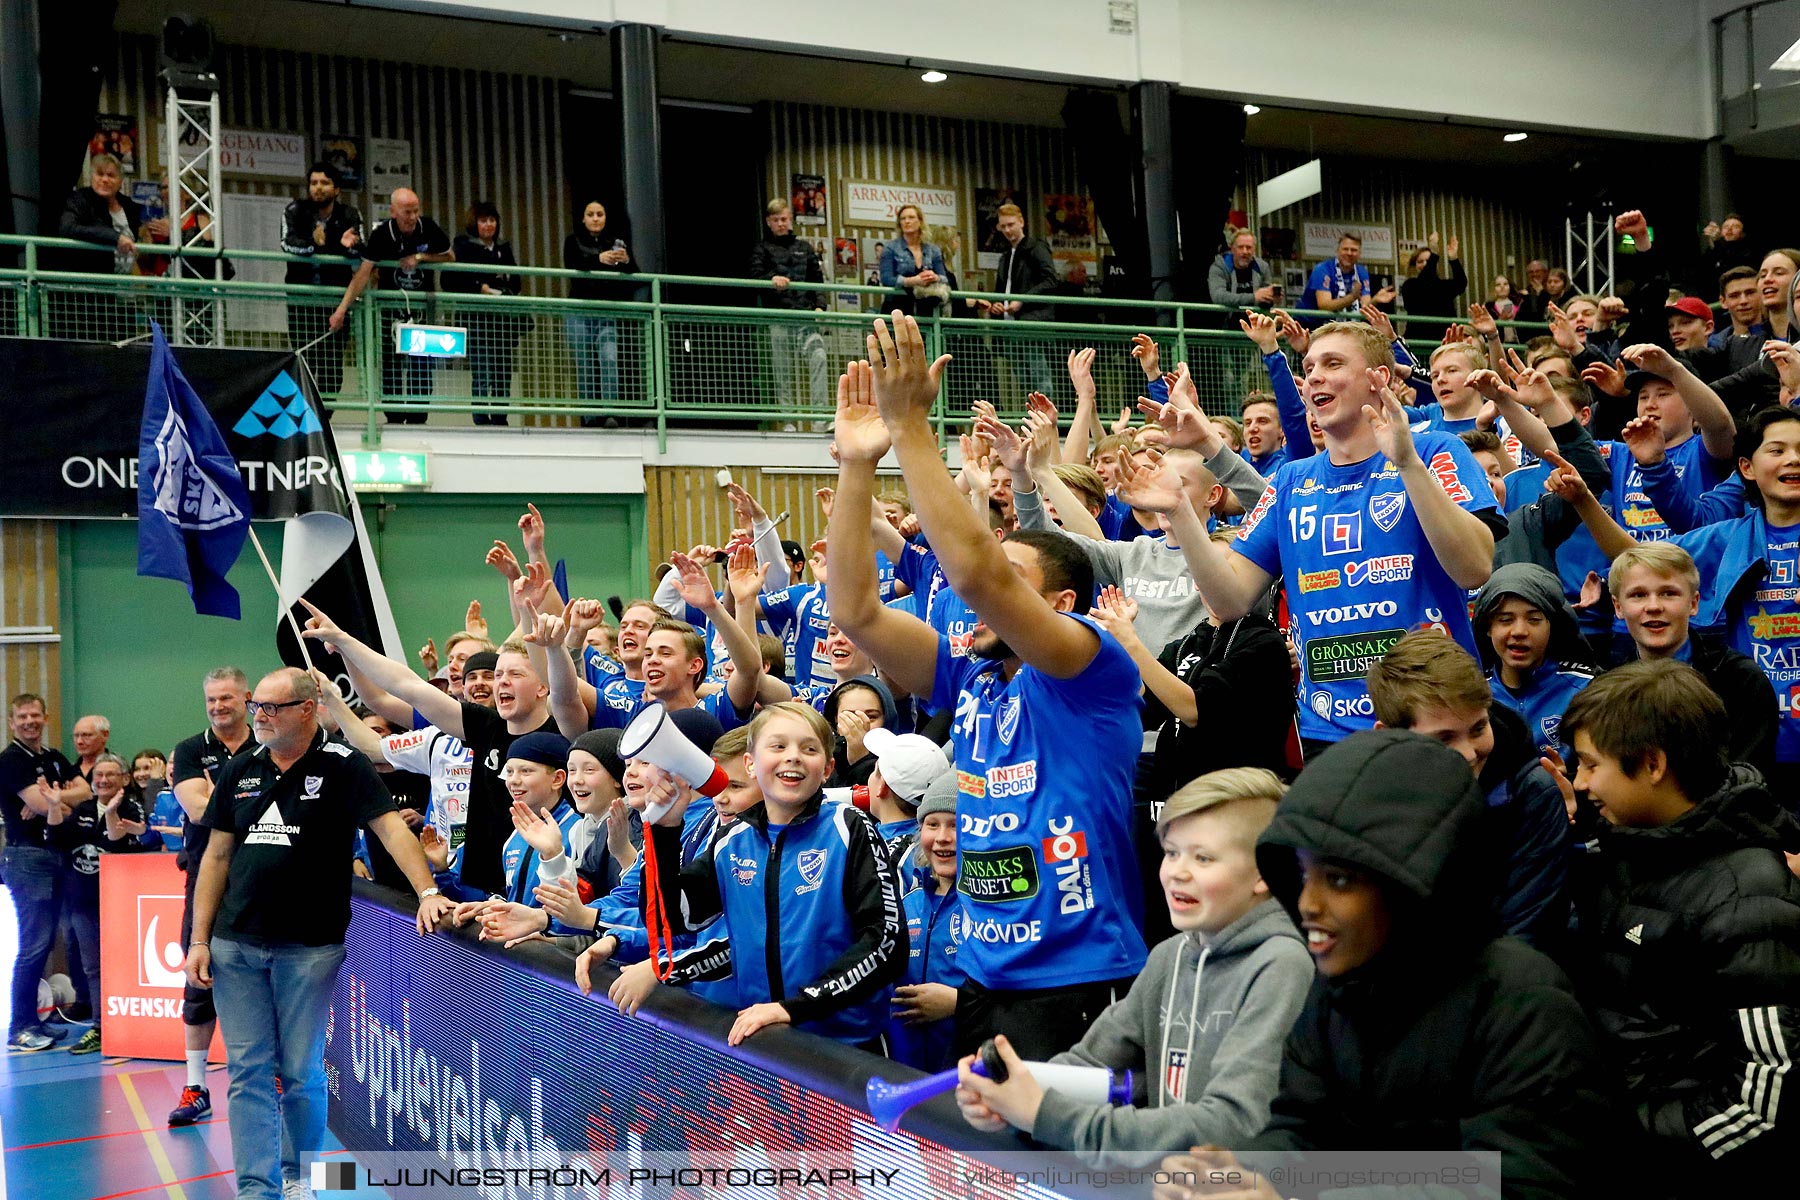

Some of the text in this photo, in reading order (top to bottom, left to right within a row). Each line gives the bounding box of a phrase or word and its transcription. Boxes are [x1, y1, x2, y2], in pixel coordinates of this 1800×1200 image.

[852, 186, 953, 207] ARRANGEMANG
[1288, 504, 1318, 544] 15
[1370, 556, 1412, 572] INTER
[1370, 567, 1412, 582] SPORT
[1123, 576, 1189, 599] C'EST LA
[1306, 600, 1398, 626] VOLVO
[389, 734, 423, 751] MAXI
[991, 763, 1034, 783] INTER
[992, 776, 1035, 796] SPORT
[1048, 815, 1086, 915] DALOC
